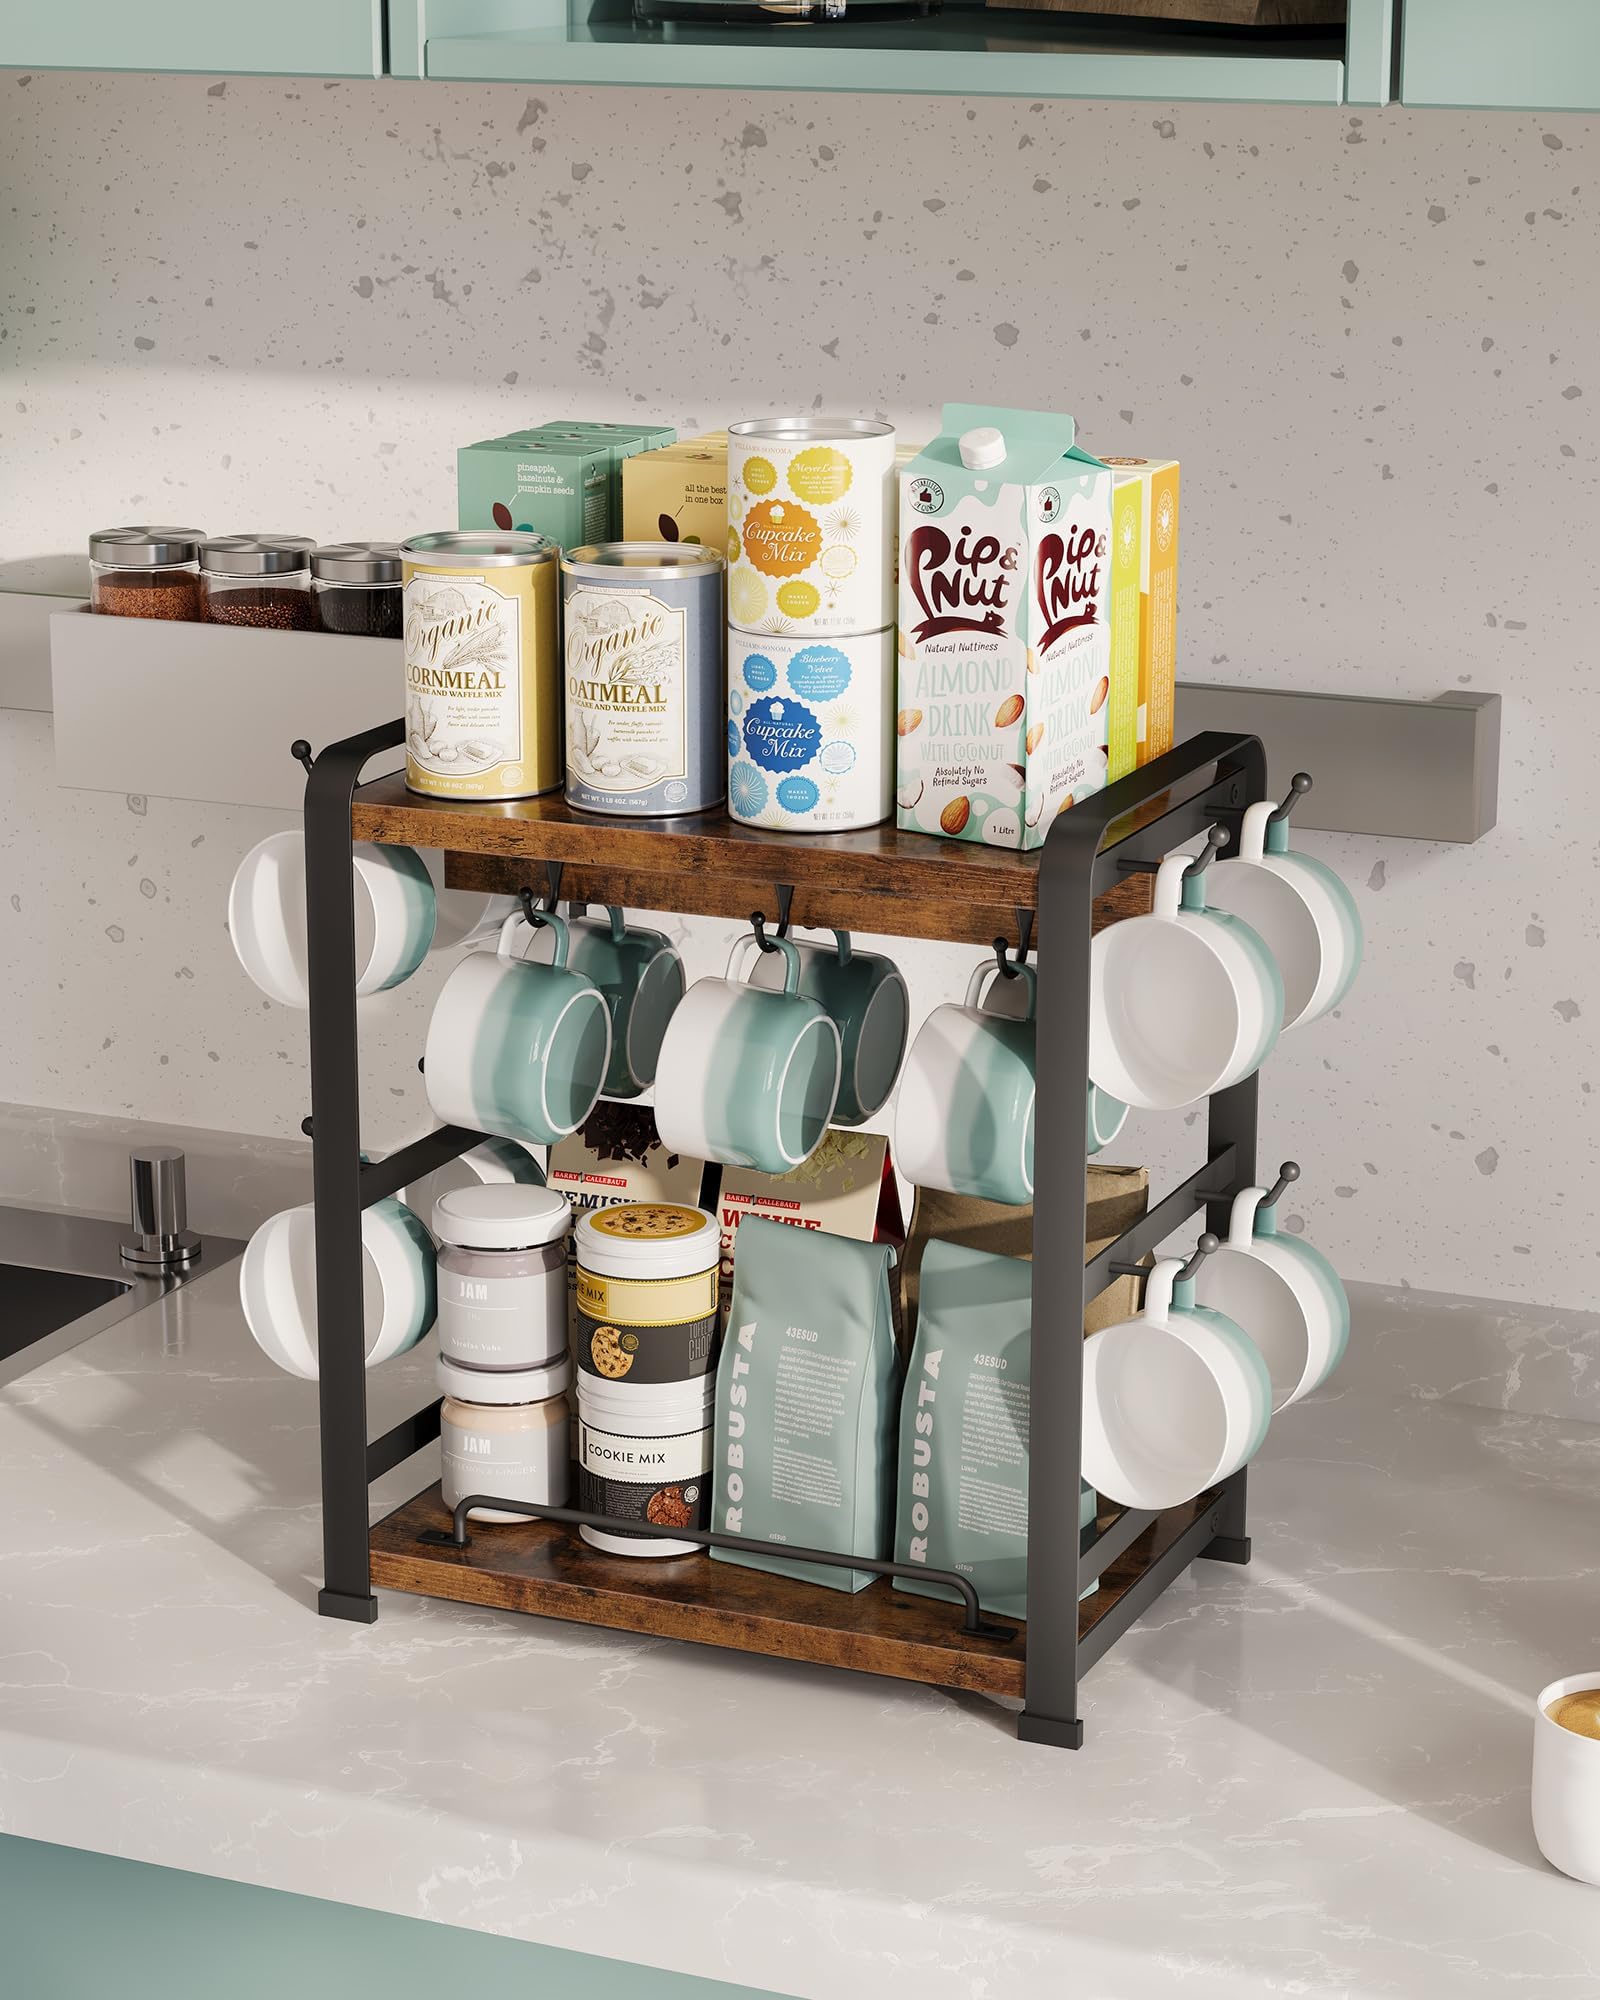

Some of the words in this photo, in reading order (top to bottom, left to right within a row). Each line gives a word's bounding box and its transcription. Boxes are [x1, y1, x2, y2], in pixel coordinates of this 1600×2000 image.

[517, 463, 556, 474] pineapple,
[518, 473, 554, 483] hazelnuts
[556, 475, 563, 483] &
[518, 484, 551, 494] pumpkin
[554, 486, 574, 495] seeds
[685, 484, 694, 492] all
[696, 485, 709, 493] the
[711, 485, 727, 495] best
[685, 495, 693, 503] in
[695, 496, 708, 504] one
[710, 495, 724, 504] box
[746, 522, 816, 544] Cupcake
[762, 543, 807, 562] Mix
[931, 568, 1010, 614] Nut
[1051, 564, 1101, 618] Nut
[406, 600, 501, 664] Organic
[567, 613, 665, 678] Organic
[925, 642, 956, 653] Natural
[959, 642, 998, 652] Nuttiness
[1046, 647, 1067, 663] Natural
[1068, 633, 1094, 652] Nuttiness
[800, 654, 839, 664] Blueberry
[407, 664, 506, 690] CORNMEAL
[916, 657, 1013, 698] ALMOND
[1041, 647, 1102, 710] ALMOND
[449, 690, 481, 698] WAFFLE
[569, 677, 667, 704] OATMEAL
[594, 704, 612, 712] AND
[613, 705, 647, 713] WAFFLE
[746, 718, 815, 740] Cupcake
[929, 702, 992, 737] DRINK
[1048, 694, 1088, 745] DRINK
[762, 739, 807, 758] Mix
[920, 742, 950, 761] WITH
[935, 766, 971, 778] Absolutely
[973, 765, 985, 776] No
[1051, 762, 1076, 782] Absolutely
[1076, 759, 1084, 770] No
[932, 776, 959, 787] Refined
[961, 776, 987, 787] Sugars
[999, 826, 1014, 835] Litre
[554, 1171, 577, 1180] BARRY
[585, 1175, 627, 1187] CALLEBAUT
[726, 1193, 750, 1203] BARRY
[757, 1198, 799, 1210] CALLEBAUT
[460, 1281, 488, 1300] JAM
[586, 1288, 605, 1302] MIX
[785, 1327, 818, 1343] 43ESUD
[973, 1353, 1008, 1369] 43ESUD
[725, 1322, 757, 1533] ROBUSTA
[463, 1435, 491, 1454] JAM
[588, 1443, 634, 1463] COOKIE
[639, 1453, 666, 1464] MIX
[910, 1349, 944, 1563] ROBUSTA
